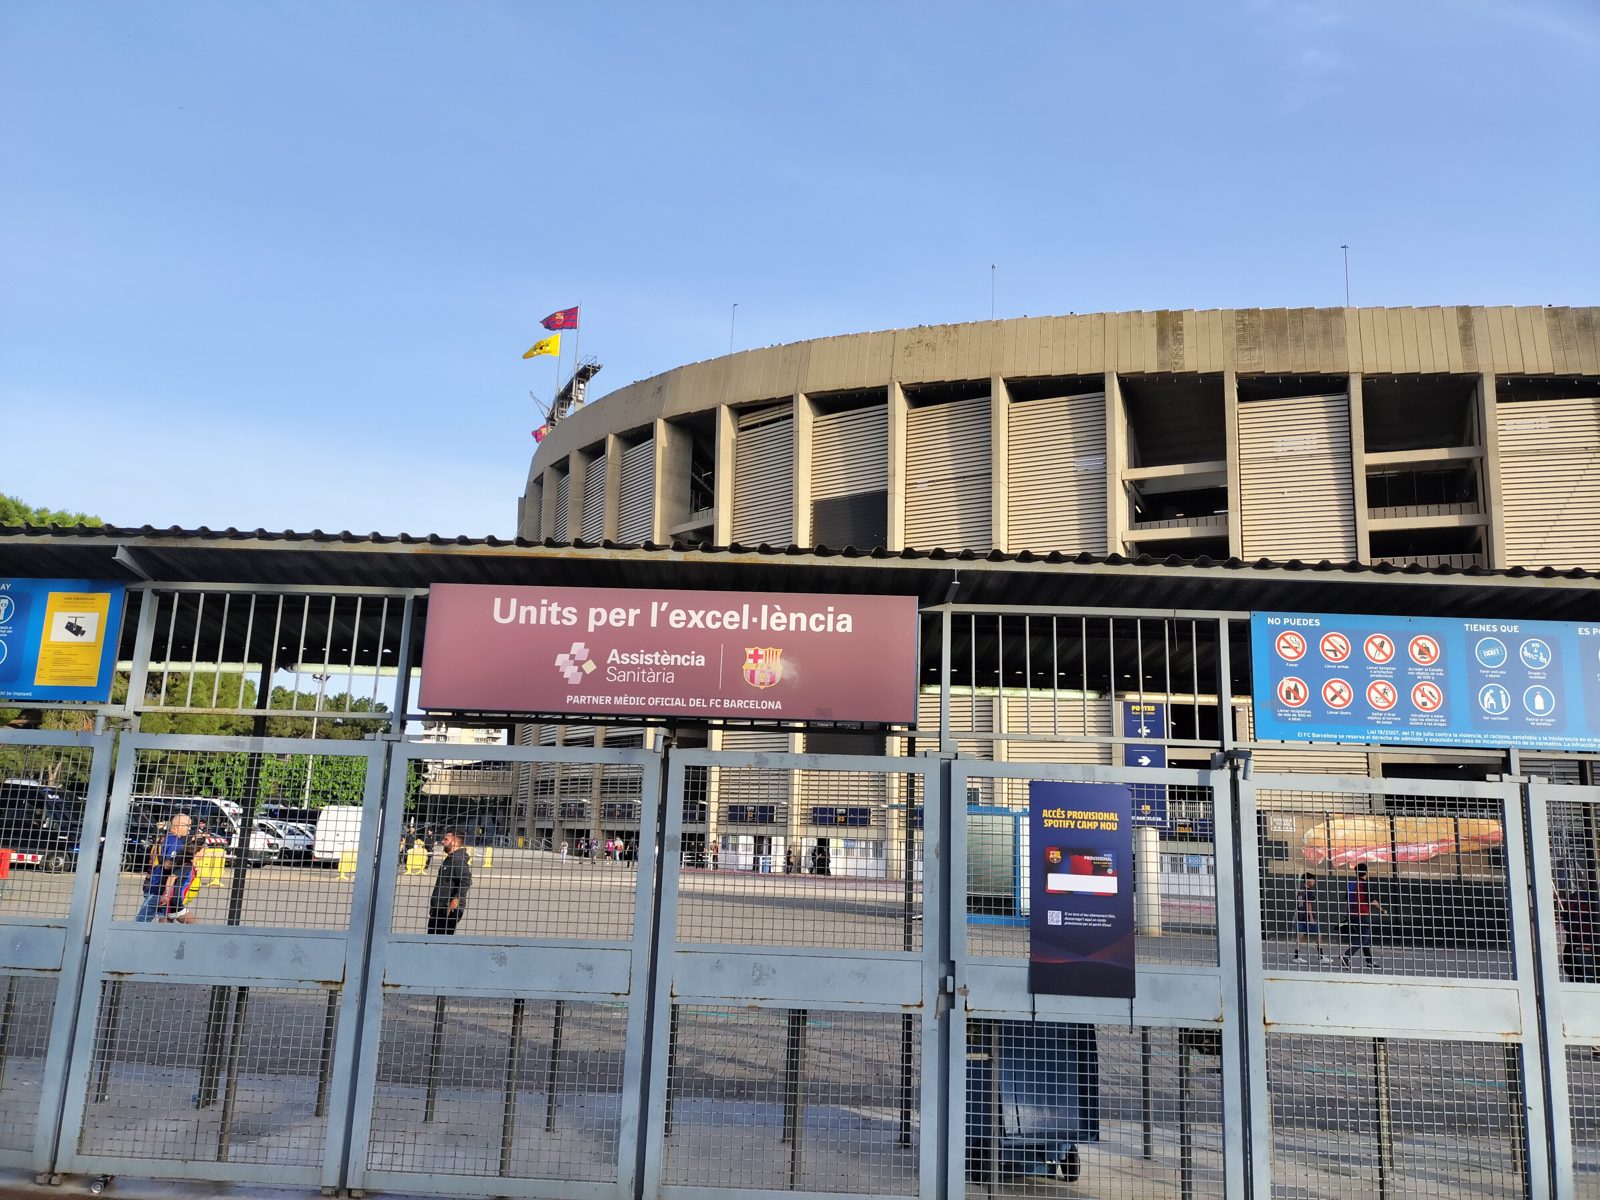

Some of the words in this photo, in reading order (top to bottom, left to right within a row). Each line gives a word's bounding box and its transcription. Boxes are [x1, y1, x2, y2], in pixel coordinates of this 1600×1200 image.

[493, 598, 578, 625] Units
[587, 607, 641, 632] per
[1267, 617, 1281, 625] NO
[1283, 617, 1321, 627] PUEDES
[1464, 623, 1498, 632] TIENES
[1500, 624, 1520, 633] QUE
[1578, 627, 1590, 635] ES
[606, 648, 705, 667] Assistència
[606, 667, 675, 684] Sanitària
[566, 695, 612, 705] PARTNER
[613, 693, 646, 706] MÈDIC
[648, 697, 687, 707] OFICIAL
[689, 698, 707, 708] DEL
[709, 699, 722, 708] FC
[723, 699, 782, 710] BARCELONA
[1042, 808, 1066, 819] ACCÉS
[1067, 810, 1119, 822] PROVISIONAL
[1043, 819, 1076, 829] SPOTIFY
[1077, 821, 1099, 830] CAMP
[1099, 822, 1118, 831] NOU
